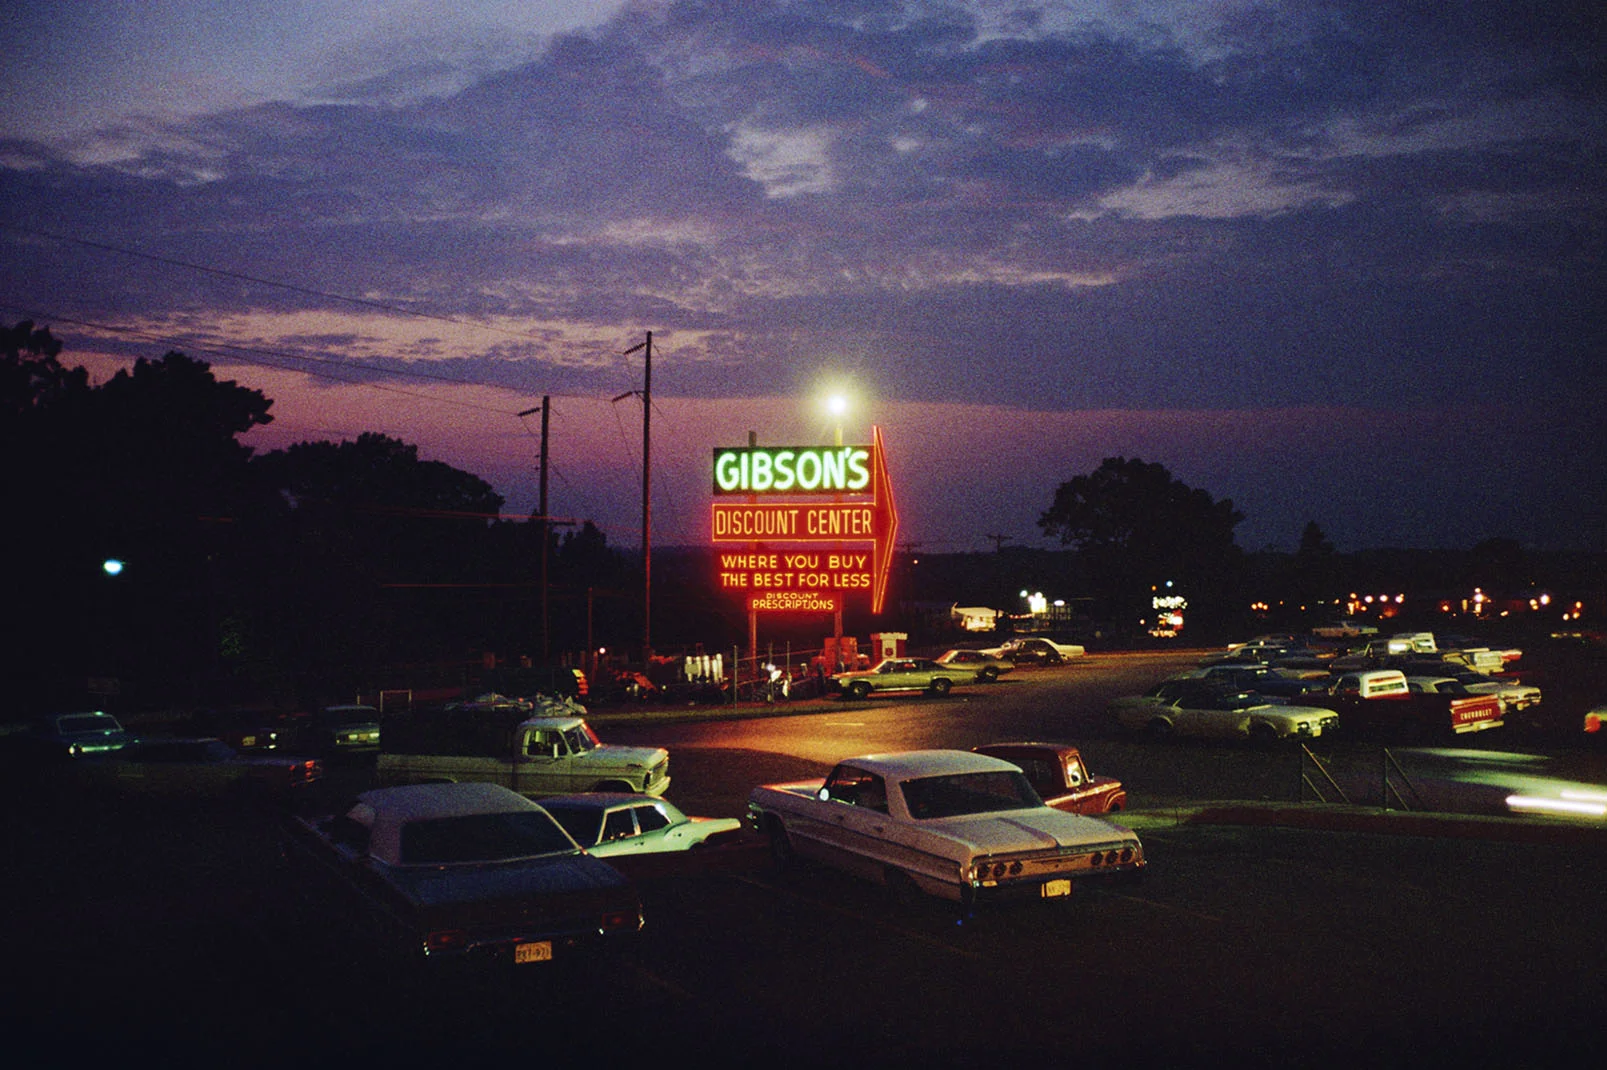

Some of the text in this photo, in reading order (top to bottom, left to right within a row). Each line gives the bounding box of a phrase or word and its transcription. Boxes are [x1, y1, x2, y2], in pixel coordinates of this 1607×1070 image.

[715, 448, 869, 490] GIBSON'S
[715, 509, 872, 535] DISCOUNT CENTER
[721, 555, 866, 569] WHERE YOU BUY
[721, 573, 870, 587] THE BEST FOR LESS
[752, 599, 834, 610] PRESCRIPTIONS
[1460, 708, 1492, 720] CHEVROLET
